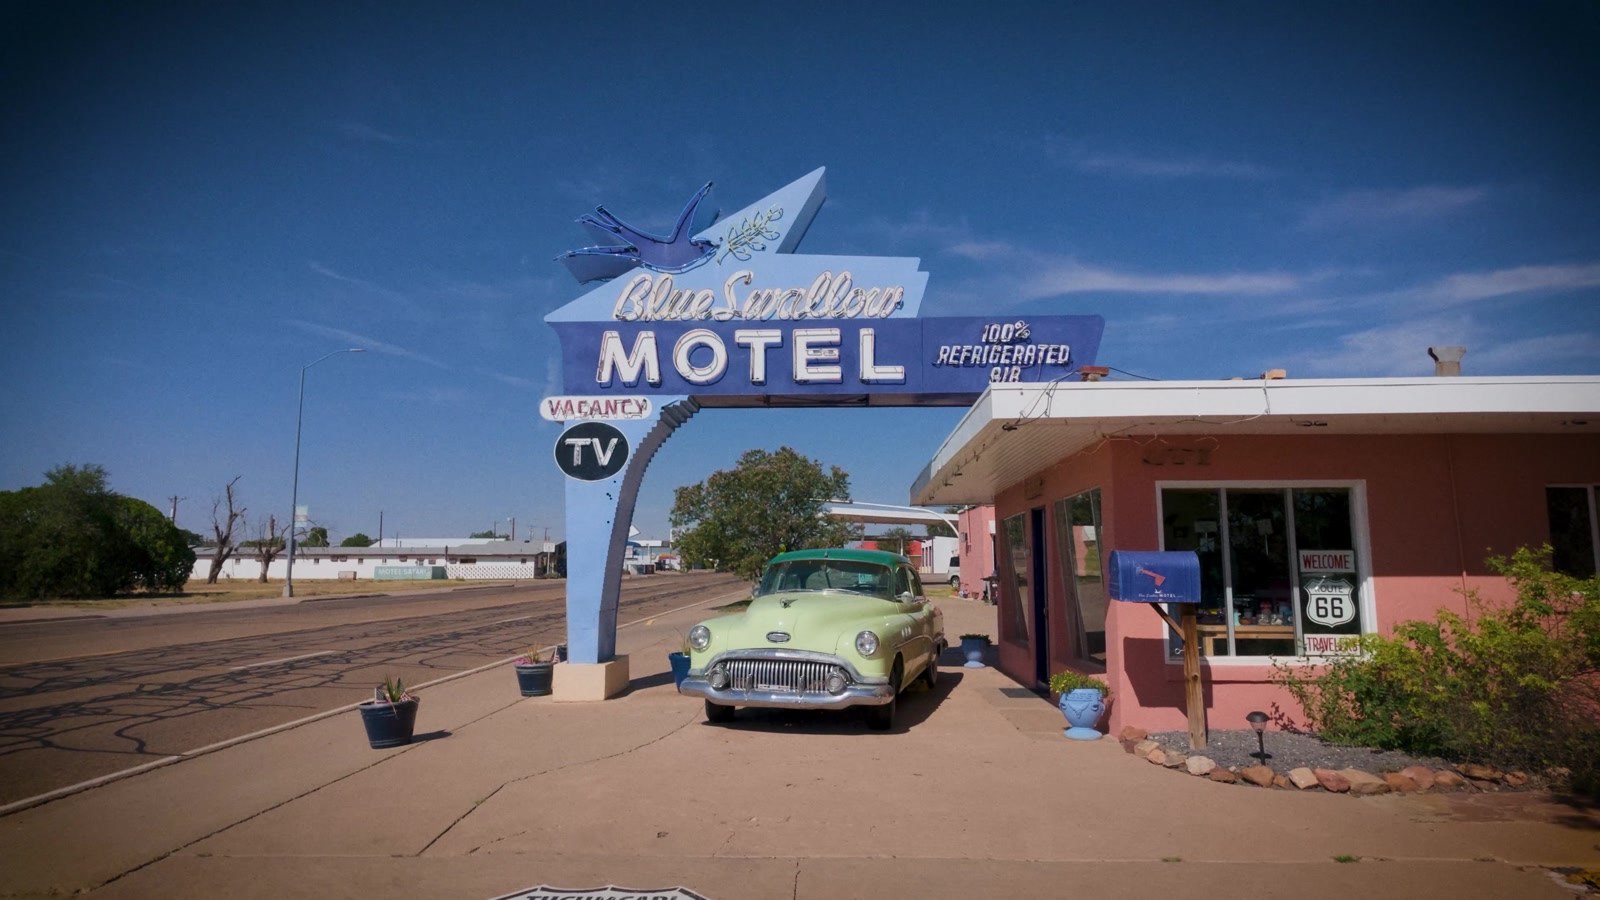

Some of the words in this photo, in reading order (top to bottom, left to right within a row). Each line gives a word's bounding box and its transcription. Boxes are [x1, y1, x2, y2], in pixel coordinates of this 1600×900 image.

[612, 272, 714, 321] Blue
[713, 270, 904, 321] Swallow
[982, 320, 1031, 342] 100%
[595, 327, 906, 385] MOTEL
[937, 344, 1070, 364] REFRIGERATED
[990, 366, 1021, 382] AIR
[547, 399, 647, 417] VACANCY
[564, 437, 619, 467] TV
[1302, 554, 1350, 569] WELCOME
[1315, 597, 1344, 619] 66
